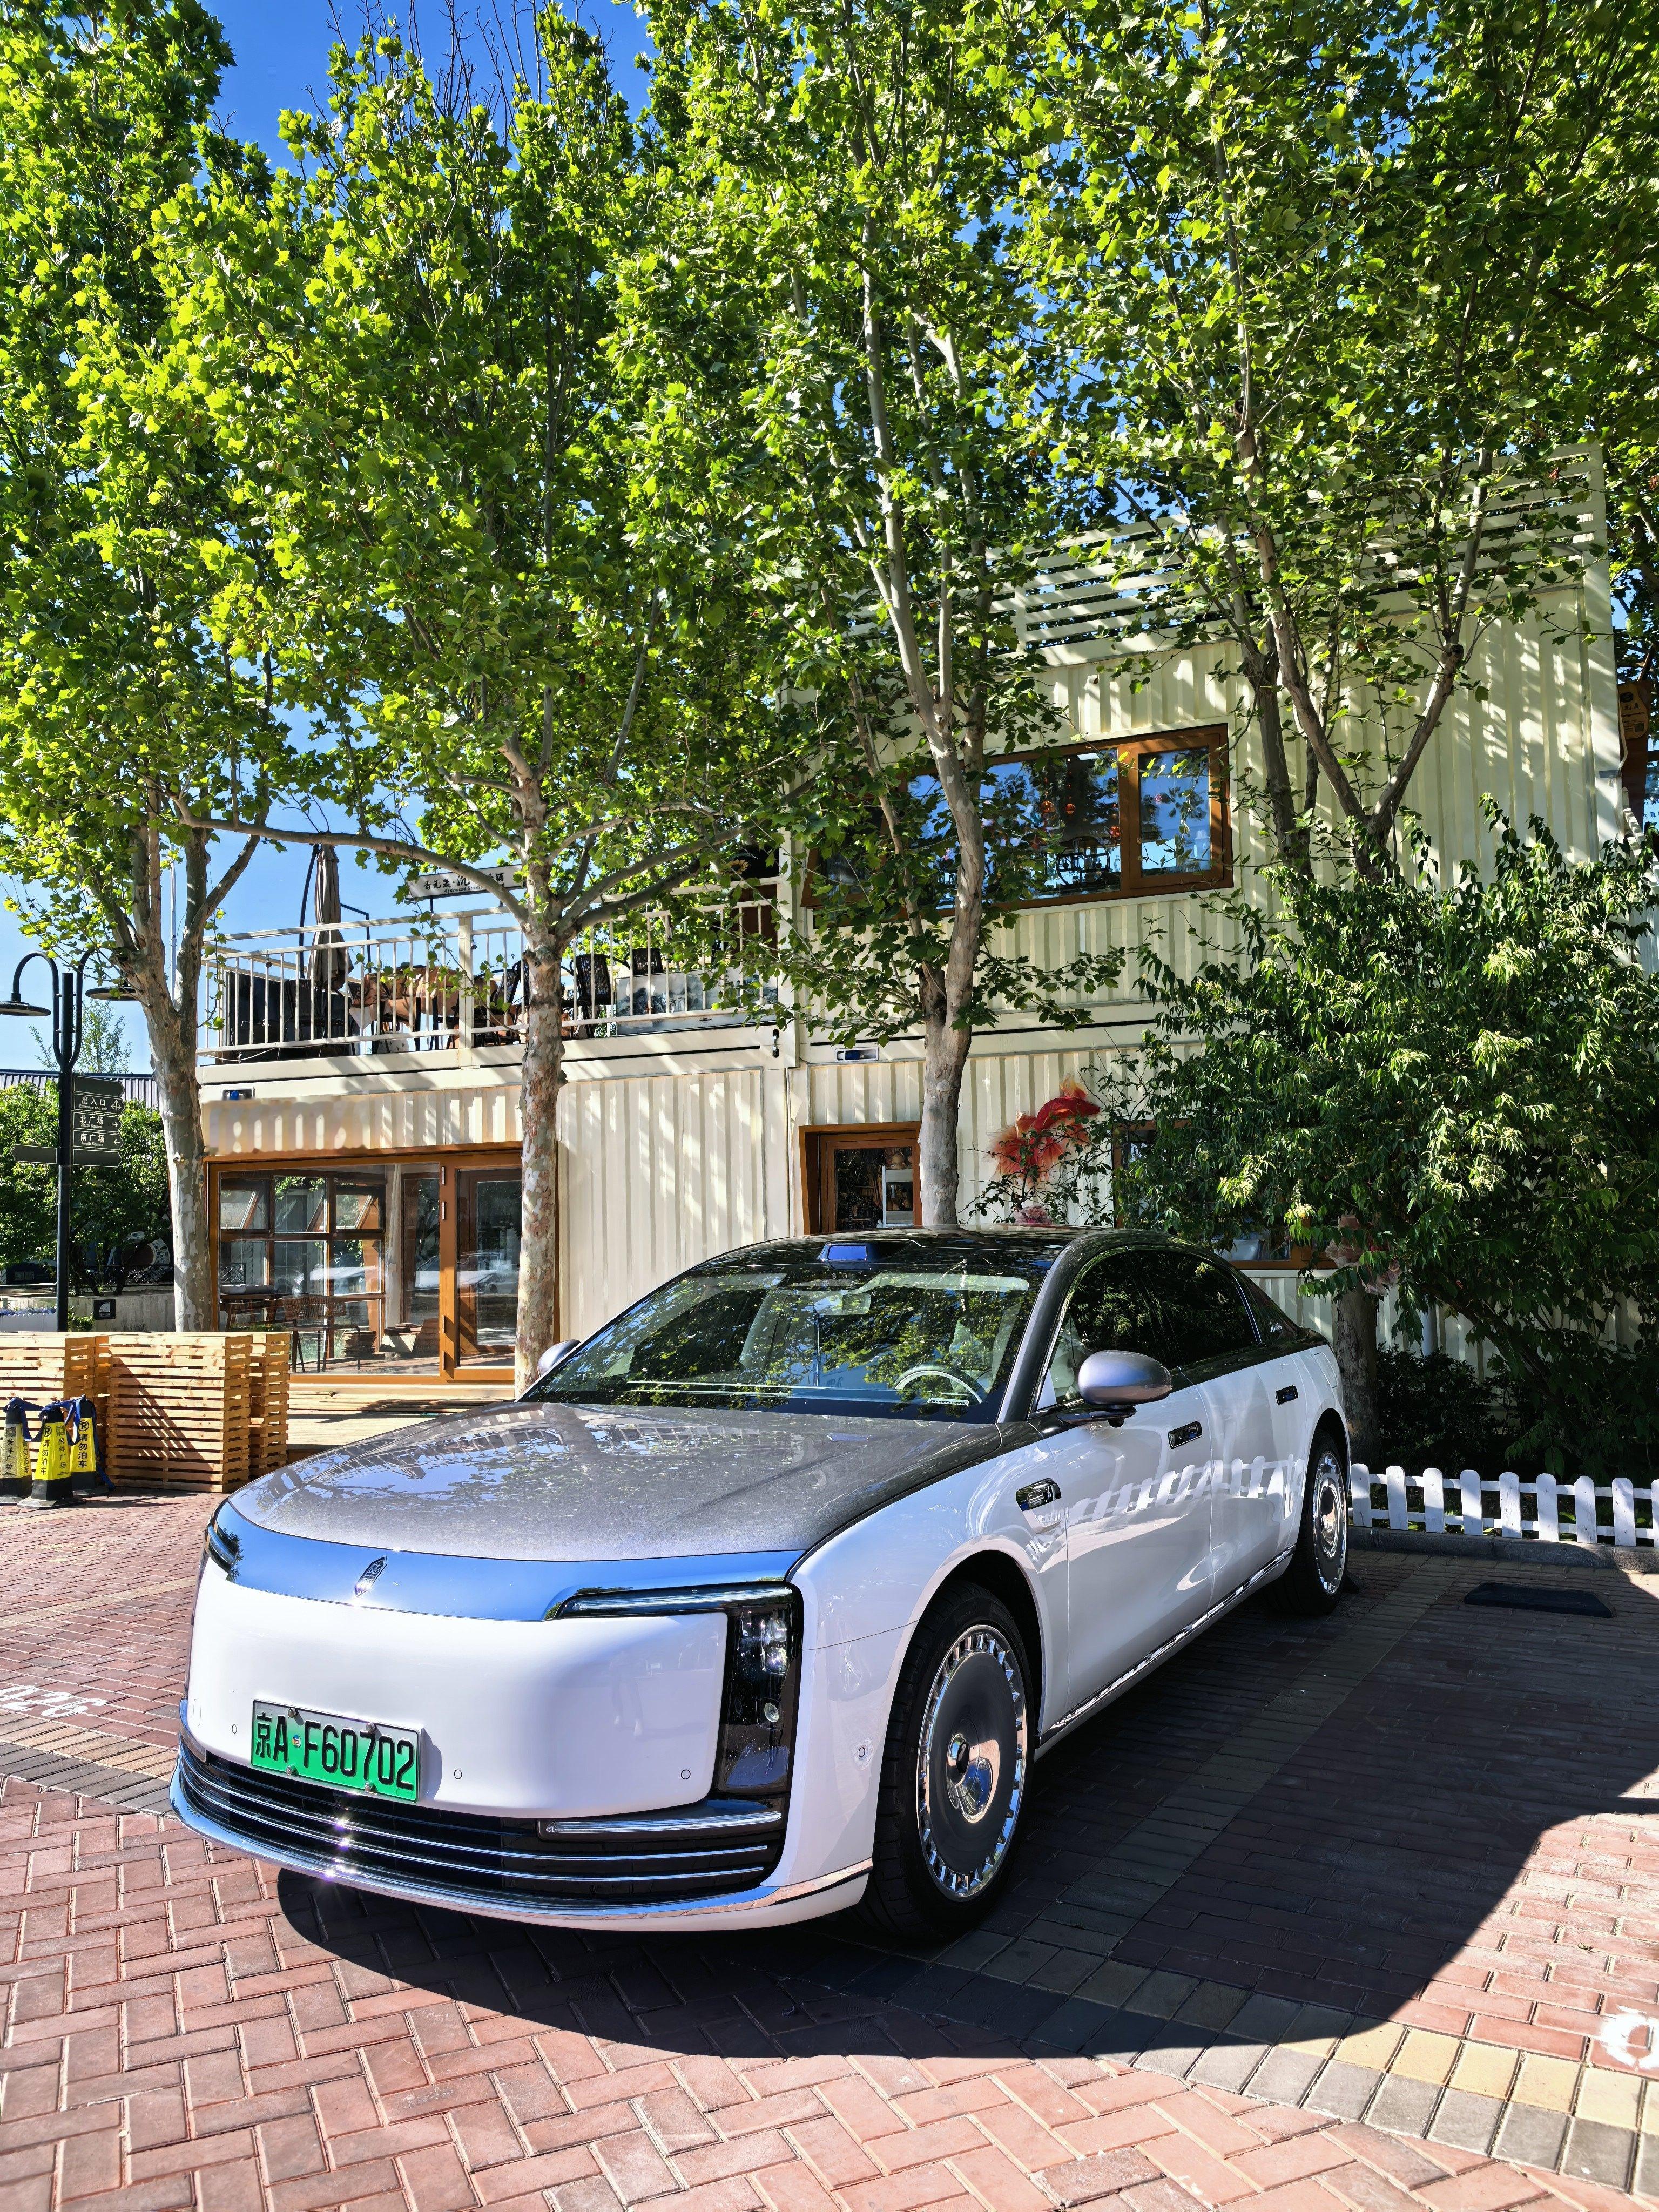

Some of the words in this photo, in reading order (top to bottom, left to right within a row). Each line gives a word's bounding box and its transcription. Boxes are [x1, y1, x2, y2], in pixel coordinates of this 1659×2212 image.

[82, 1096, 105, 1106] 出入口
[80, 1115, 104, 1125] 北广场
[80, 1132, 105, 1143] 南广场
[5, 1439, 14, 1471] 荣祥广场
[40, 1439, 50, 1475] 请勿泊车
[58, 1437, 66, 1469] 荣祥广场
[78, 1433, 88, 1468] 请勿泊车
